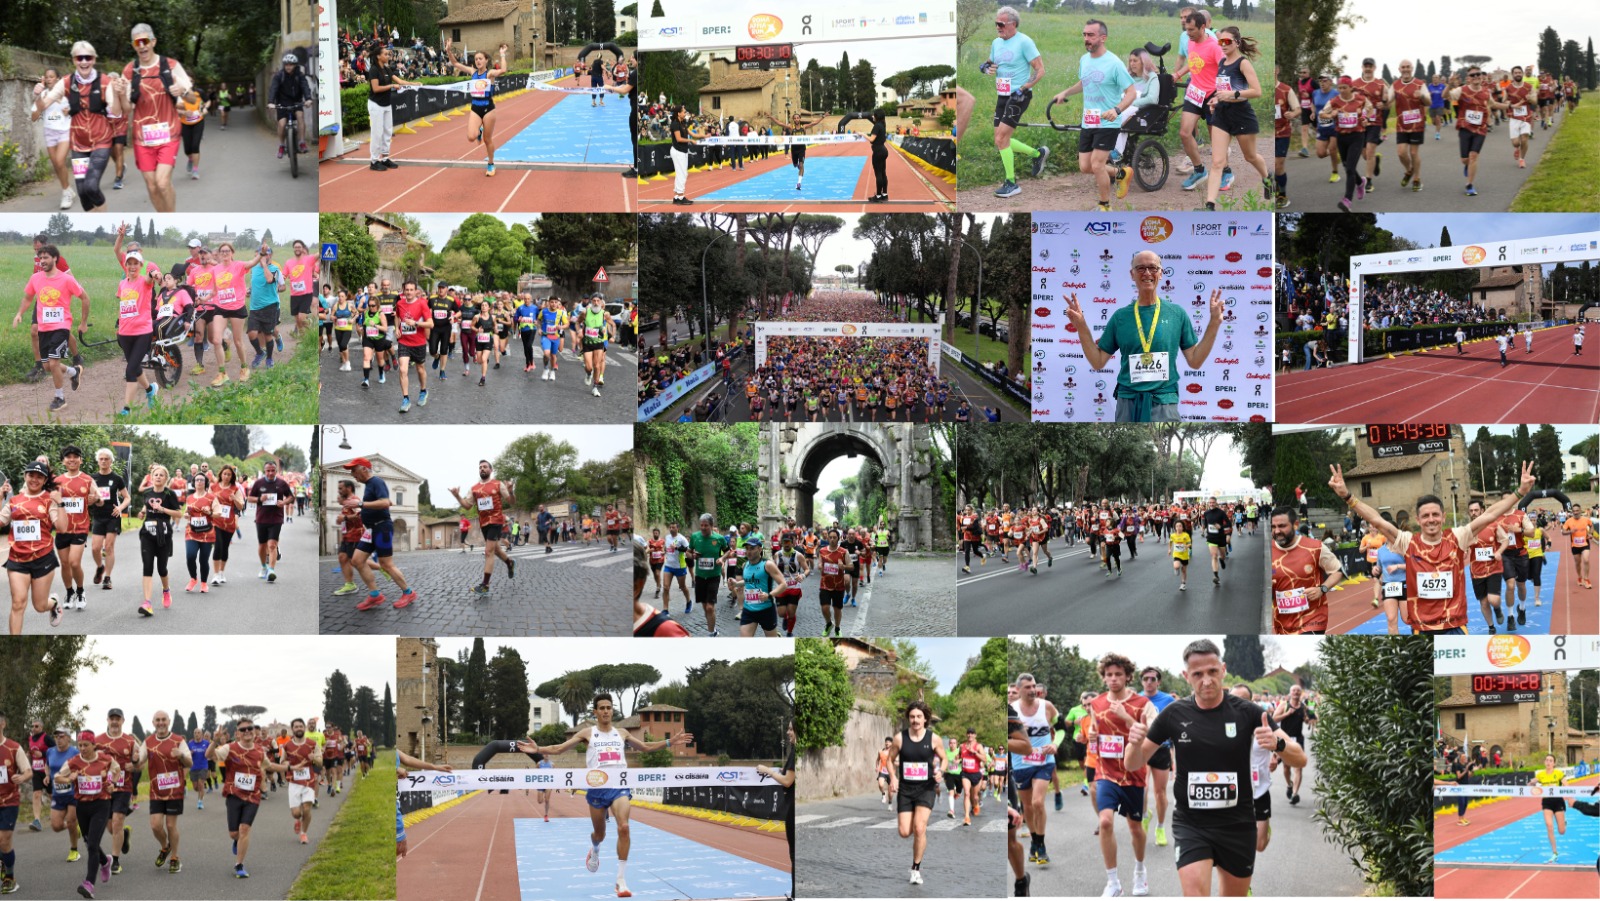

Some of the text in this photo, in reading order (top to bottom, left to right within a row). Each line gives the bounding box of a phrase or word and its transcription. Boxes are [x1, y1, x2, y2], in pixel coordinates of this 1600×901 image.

[16, 525, 36, 534] 8080
[1422, 578, 1447, 588] 4573
[1474, 673, 1540, 692] 00:34:28
[526, 774, 554, 782] BPER:
[638, 774, 666, 782] BPER:
[1196, 786, 1228, 800] 8581
